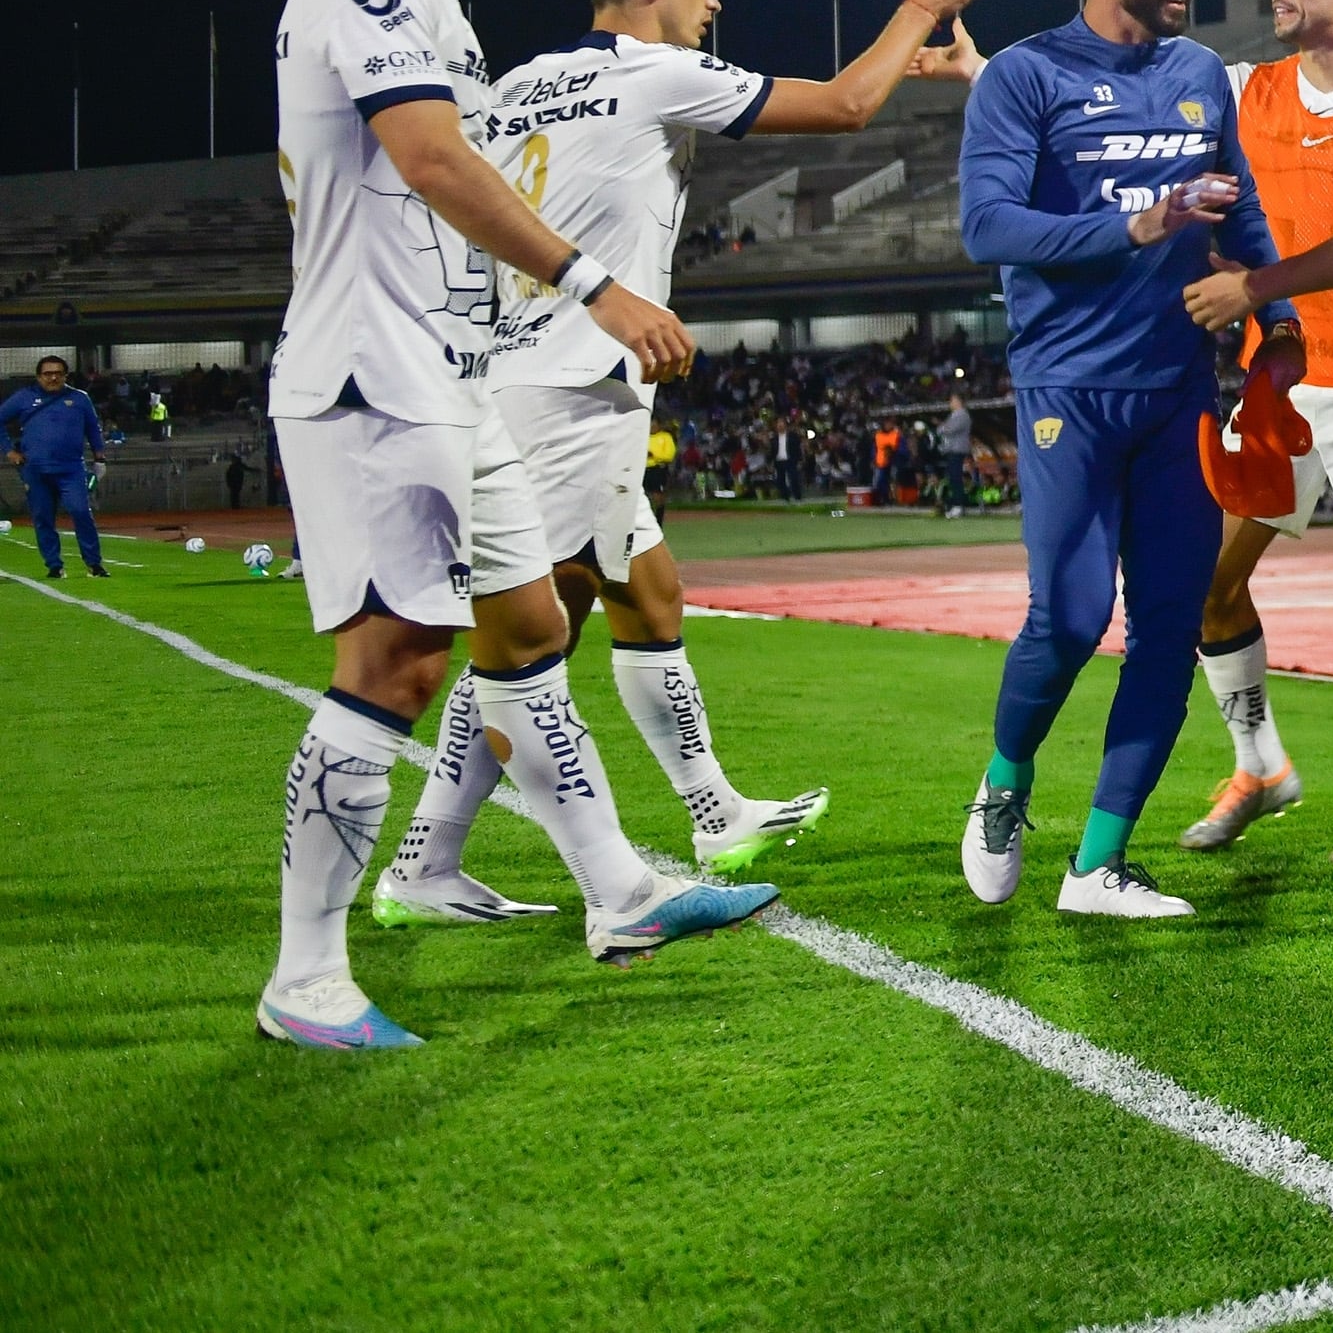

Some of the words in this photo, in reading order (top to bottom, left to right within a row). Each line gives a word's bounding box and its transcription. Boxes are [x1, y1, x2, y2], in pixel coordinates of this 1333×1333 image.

[1093, 84, 1114, 103] 33
[1100, 133, 1208, 161] DHL
[525, 692, 596, 805] BRIDGE
